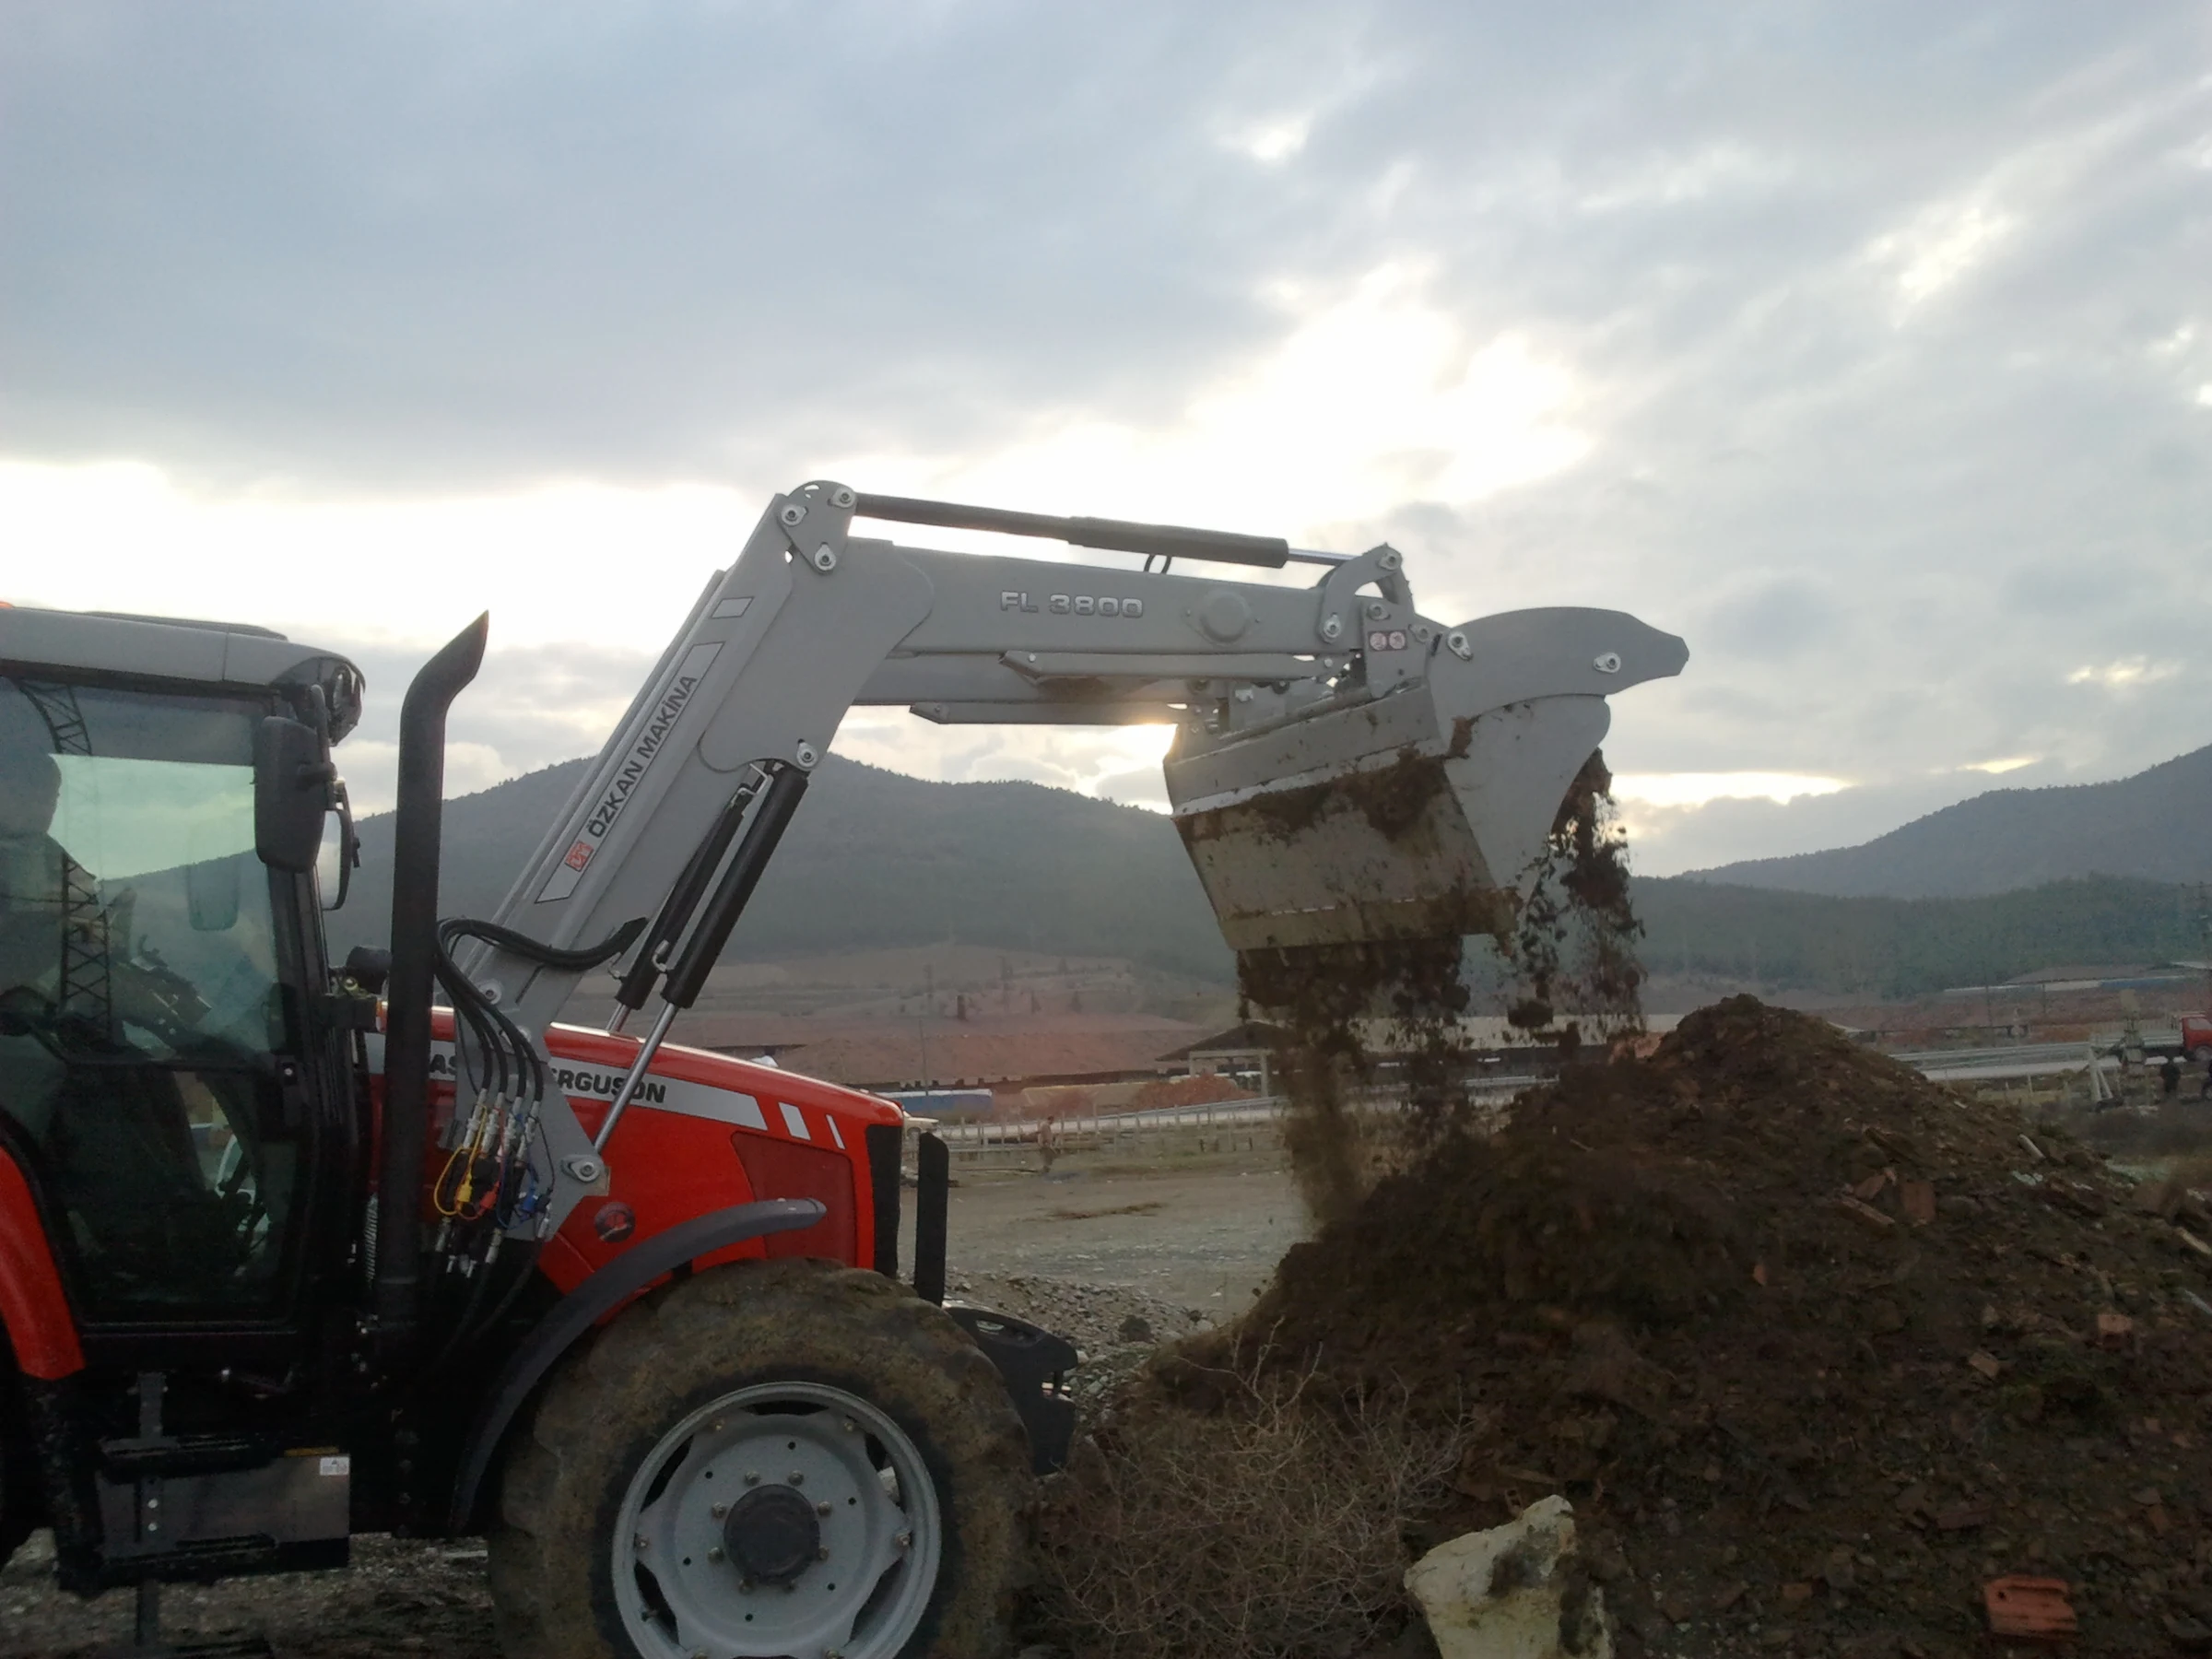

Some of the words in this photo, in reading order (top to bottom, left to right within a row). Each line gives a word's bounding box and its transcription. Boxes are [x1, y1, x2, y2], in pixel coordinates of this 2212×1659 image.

[1001, 590, 1039, 614] FL
[1049, 594, 1144, 618] 3800
[587, 760, 643, 838] ÖZKAN
[552, 1067, 666, 1103] RGUSON
